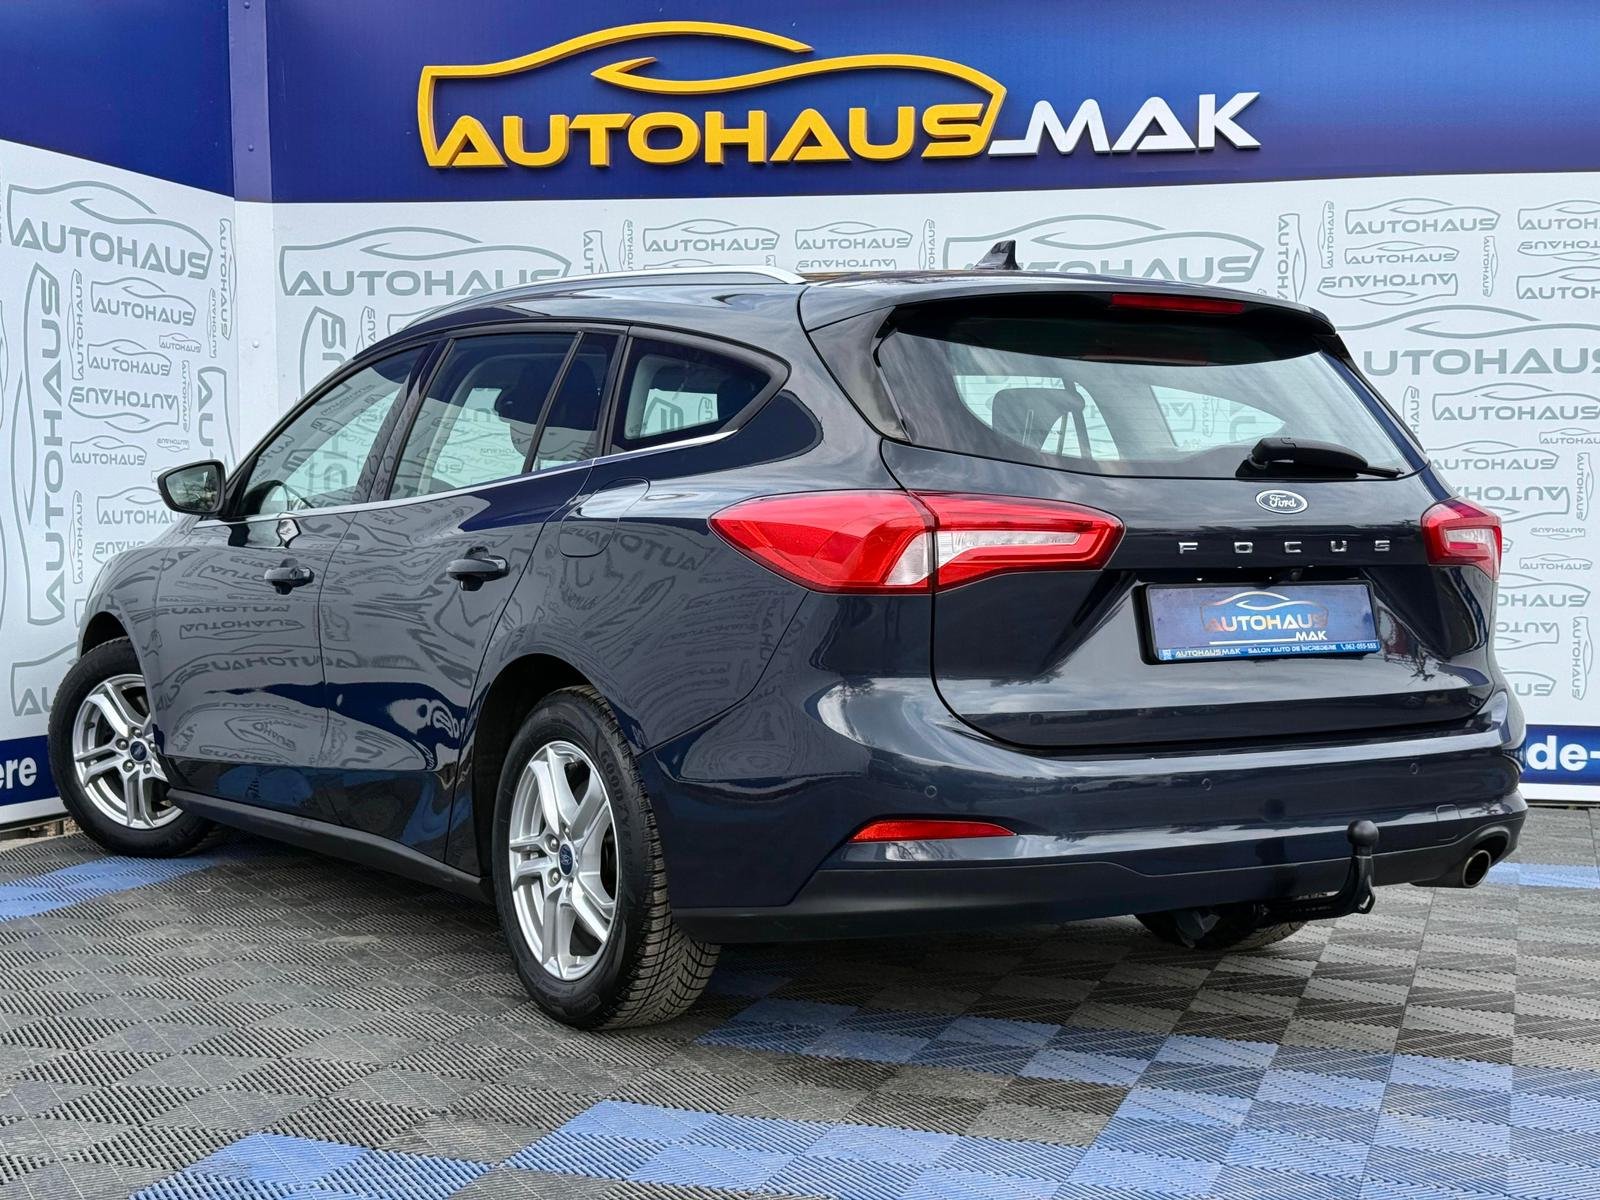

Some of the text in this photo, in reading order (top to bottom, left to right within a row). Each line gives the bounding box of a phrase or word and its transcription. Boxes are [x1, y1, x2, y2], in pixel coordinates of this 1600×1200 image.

[428, 92, 1262, 169] AUTOHAUS MAK
[1348, 217, 1496, 235] AUTOHAUS
[1520, 218, 1600, 231] AUTOH
[1326, 202, 1334, 267] AUTOHAUS
[12, 217, 211, 281] AUTOHAUS
[646, 237, 777, 252] AUTOHAUS
[797, 237, 909, 250] AUTOHAUS
[798, 259, 894, 268] AUTOHAUS
[1347, 252, 1457, 265] AUTOHAUS
[1482, 236, 1491, 297] AUTOHAUS
[219, 220, 231, 340] AUTOHAUS
[1321, 272, 1456, 289] AUTOHAUS
[92, 296, 195, 327] AUTOHAUS
[76, 270, 84, 379] AUTOHAUS
[160, 341, 200, 353] AUTOHAUS
[89, 358, 171, 377] AUTOHAUS
[70, 386, 179, 411] AUTOHAUS
[1436, 406, 1600, 421] AUTOHAUS
[41, 275, 66, 620] AUTOHAUS
[72, 451, 145, 466] AUTOHAUS
[1432, 458, 1557, 471] AUTOHAUS
[1576, 452, 1585, 519] AUTOHAUS
[1268, 494, 1297, 508] Ford
[1178, 539, 1391, 555] FOCUS
[1520, 563, 1590, 571] AUTOHAUS
[1294, 630, 1328, 641] MAK
[1571, 619, 1581, 700] AUTOHAUS
